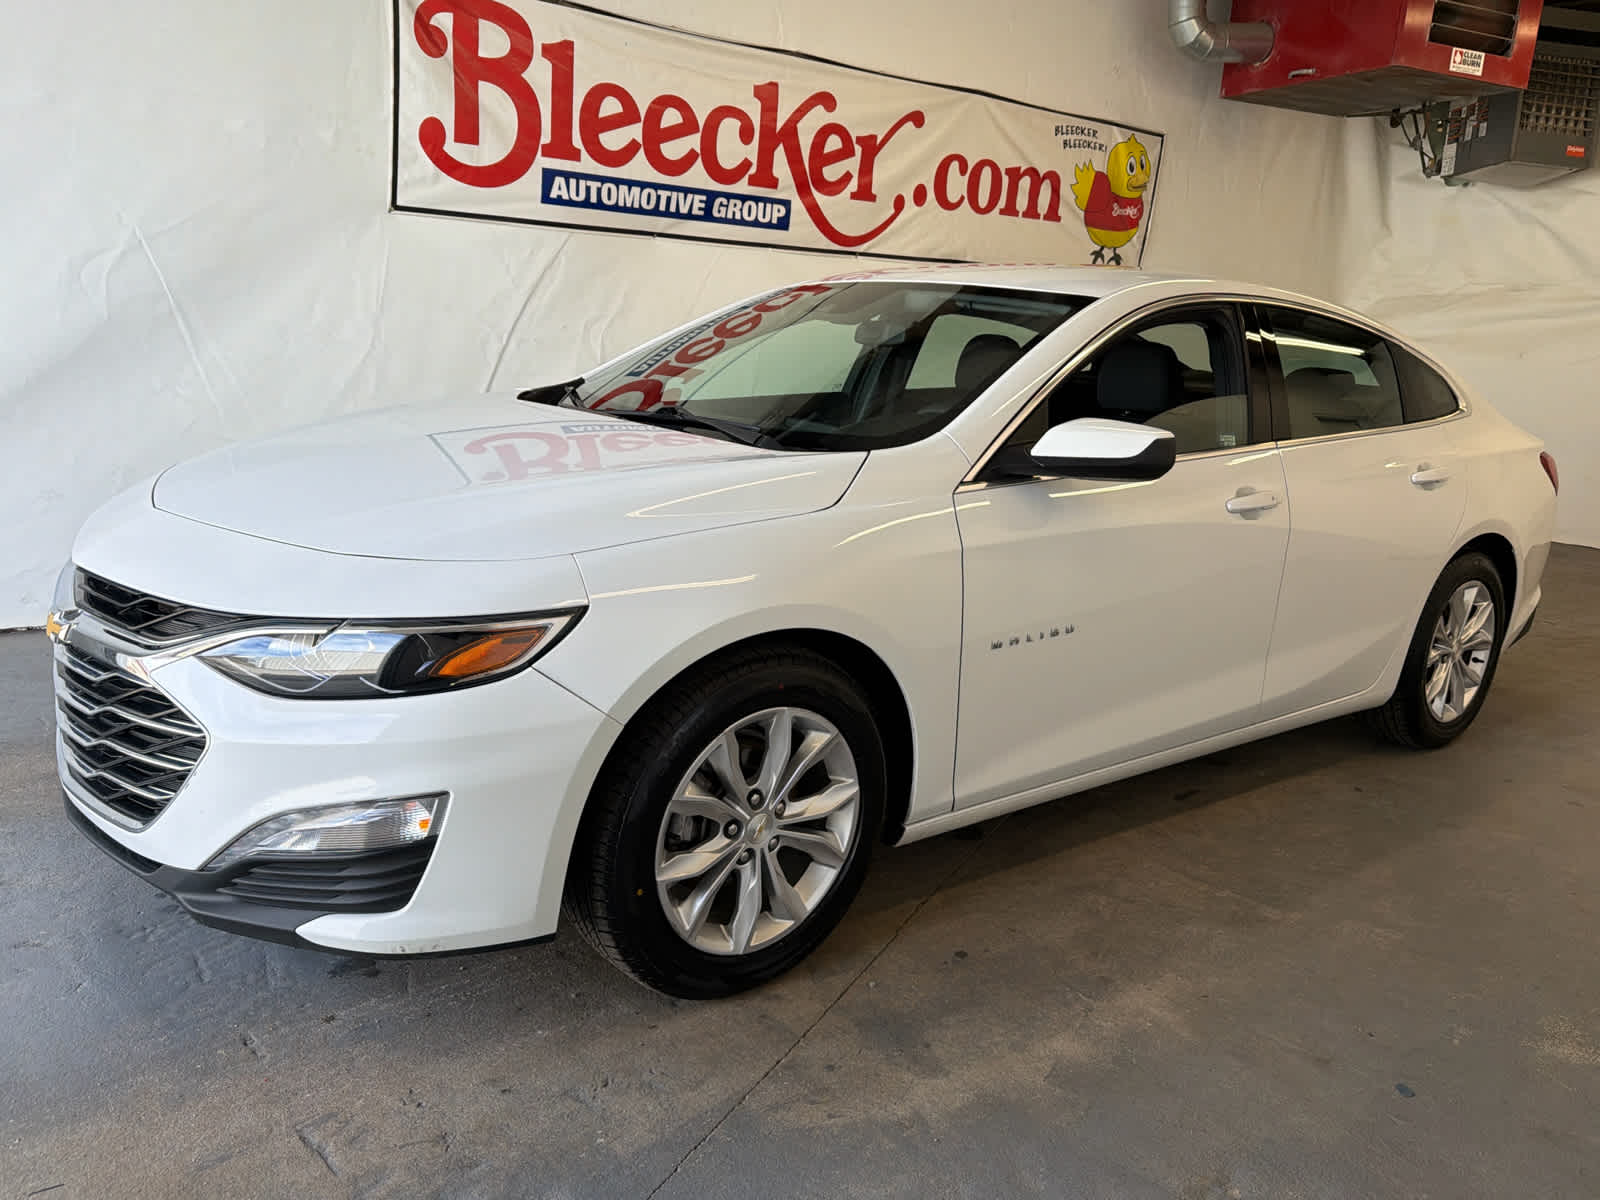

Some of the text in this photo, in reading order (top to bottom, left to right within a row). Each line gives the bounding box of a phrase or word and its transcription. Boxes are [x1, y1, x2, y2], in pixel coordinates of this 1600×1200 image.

[1464, 51, 1482, 60] CLEAN
[1463, 59, 1481, 68] BURN
[1054, 125, 1098, 139] BLEECKER
[550, 176, 787, 225] AUTOMOTIVE GROUP
